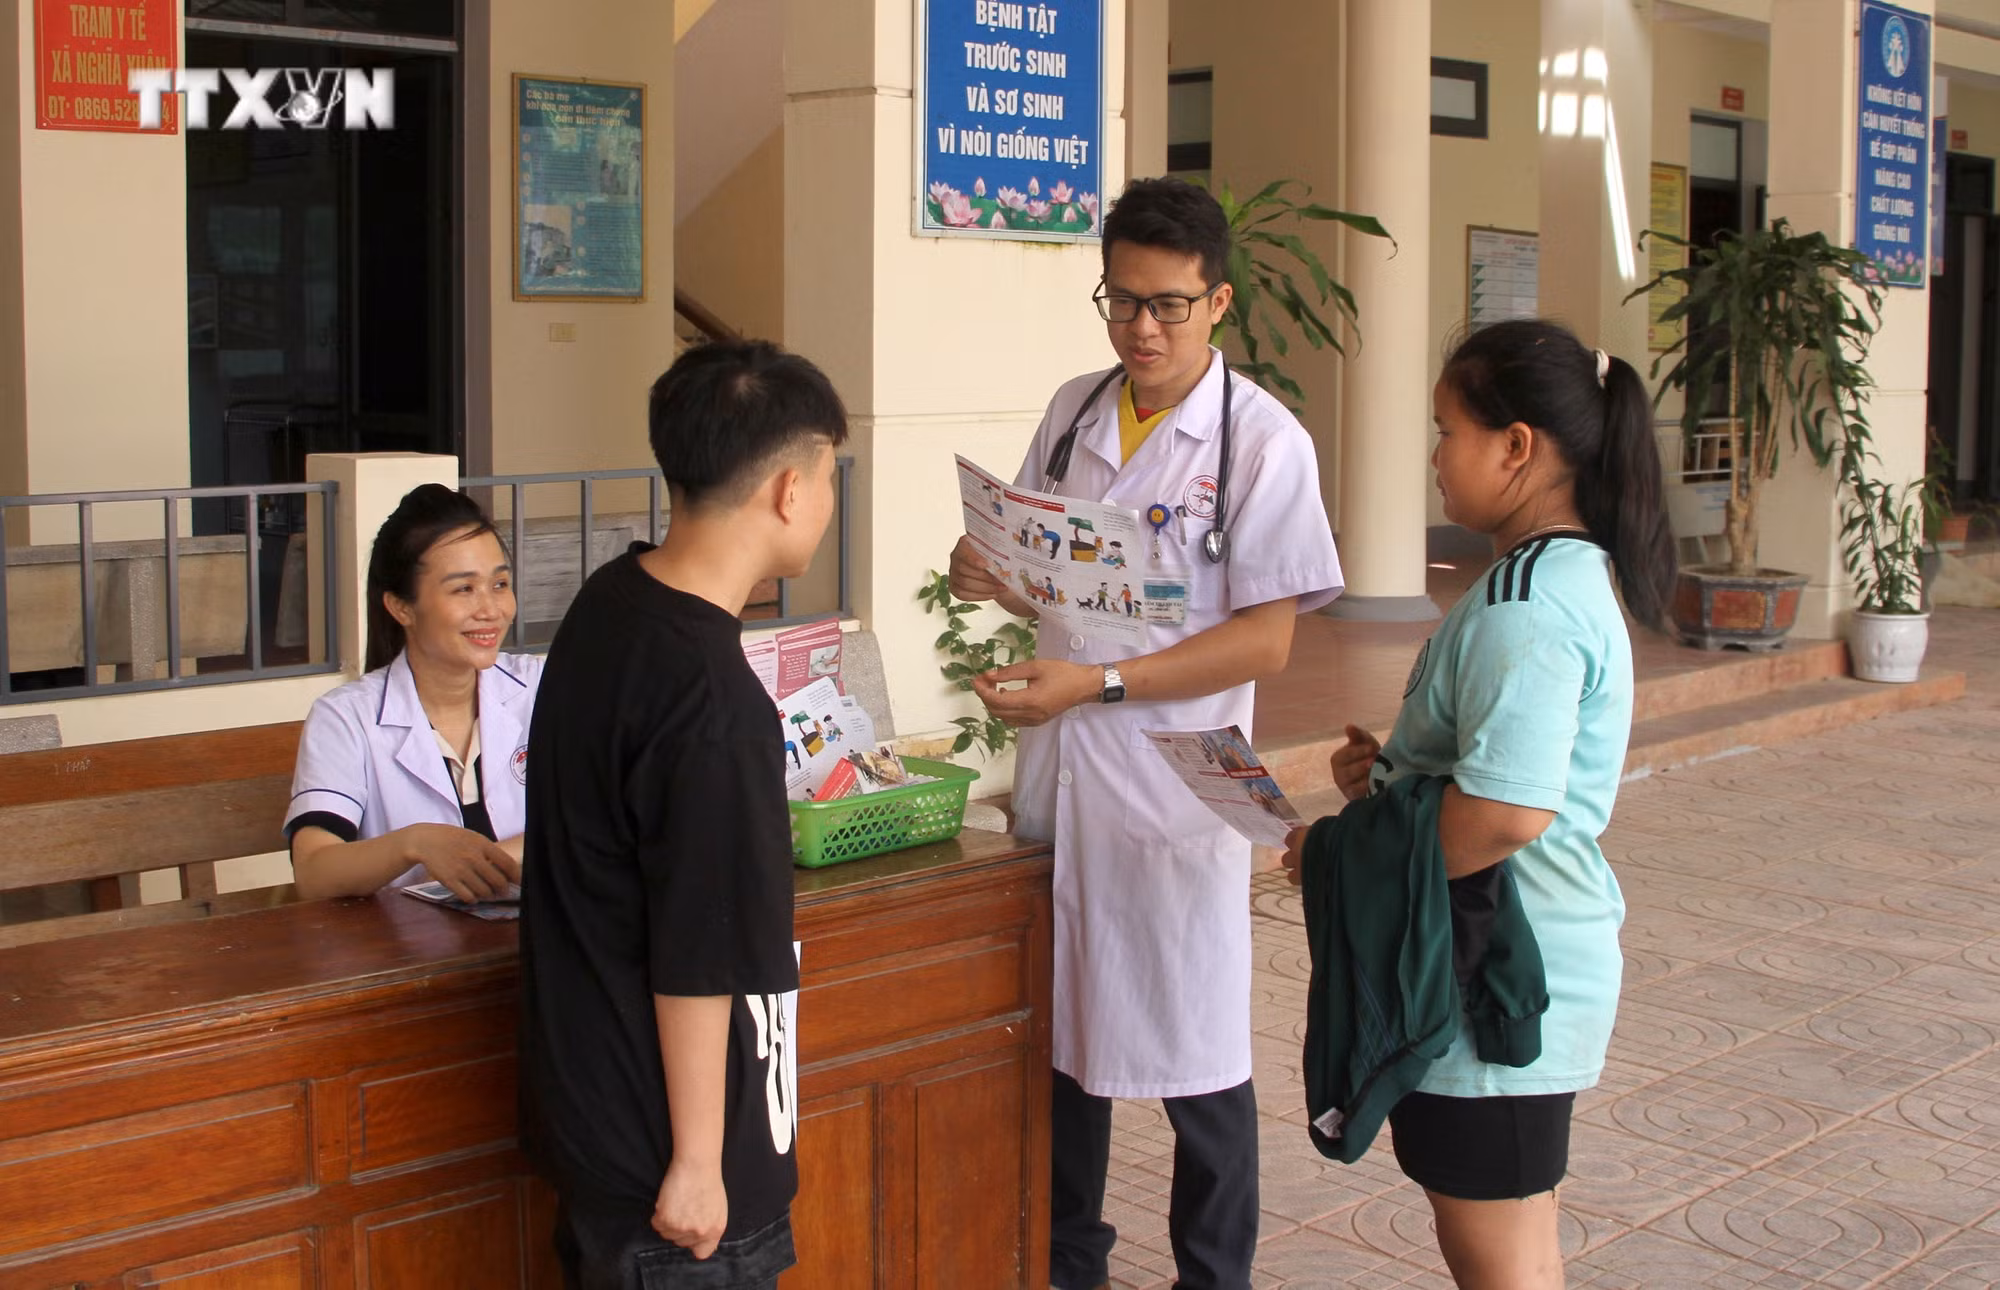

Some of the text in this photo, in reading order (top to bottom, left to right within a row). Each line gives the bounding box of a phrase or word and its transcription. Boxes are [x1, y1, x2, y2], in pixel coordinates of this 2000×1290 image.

[70, 0, 147, 45] TRẠM Y TẾ
[975, 0, 1058, 38] BỆNH TẬT
[51, 44, 72, 83] XÃ
[76, 46, 122, 85] NGHĨA
[964, 41, 1067, 78] TRƯỚC SINH
[966, 82, 1064, 120] VÀ SƠ SINH
[938, 123, 1089, 169] VÌ NÒI GIỐNG VIỆT
